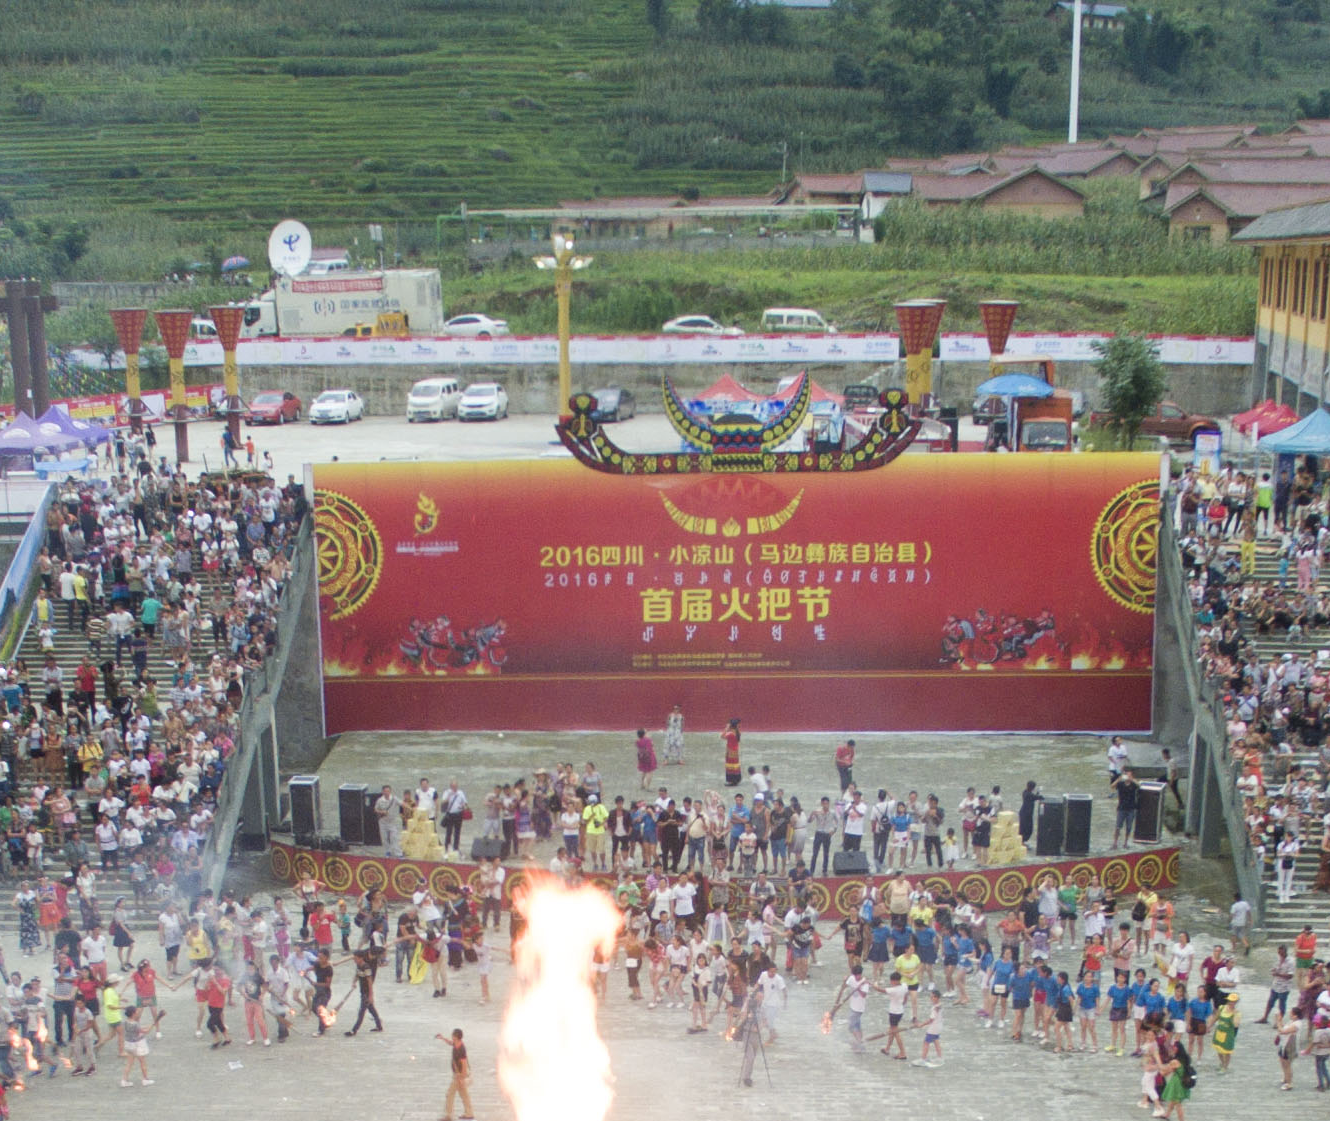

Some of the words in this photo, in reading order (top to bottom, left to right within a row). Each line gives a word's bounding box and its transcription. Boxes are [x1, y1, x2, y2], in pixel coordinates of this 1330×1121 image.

[639, 587, 832, 622] 首届火把节
